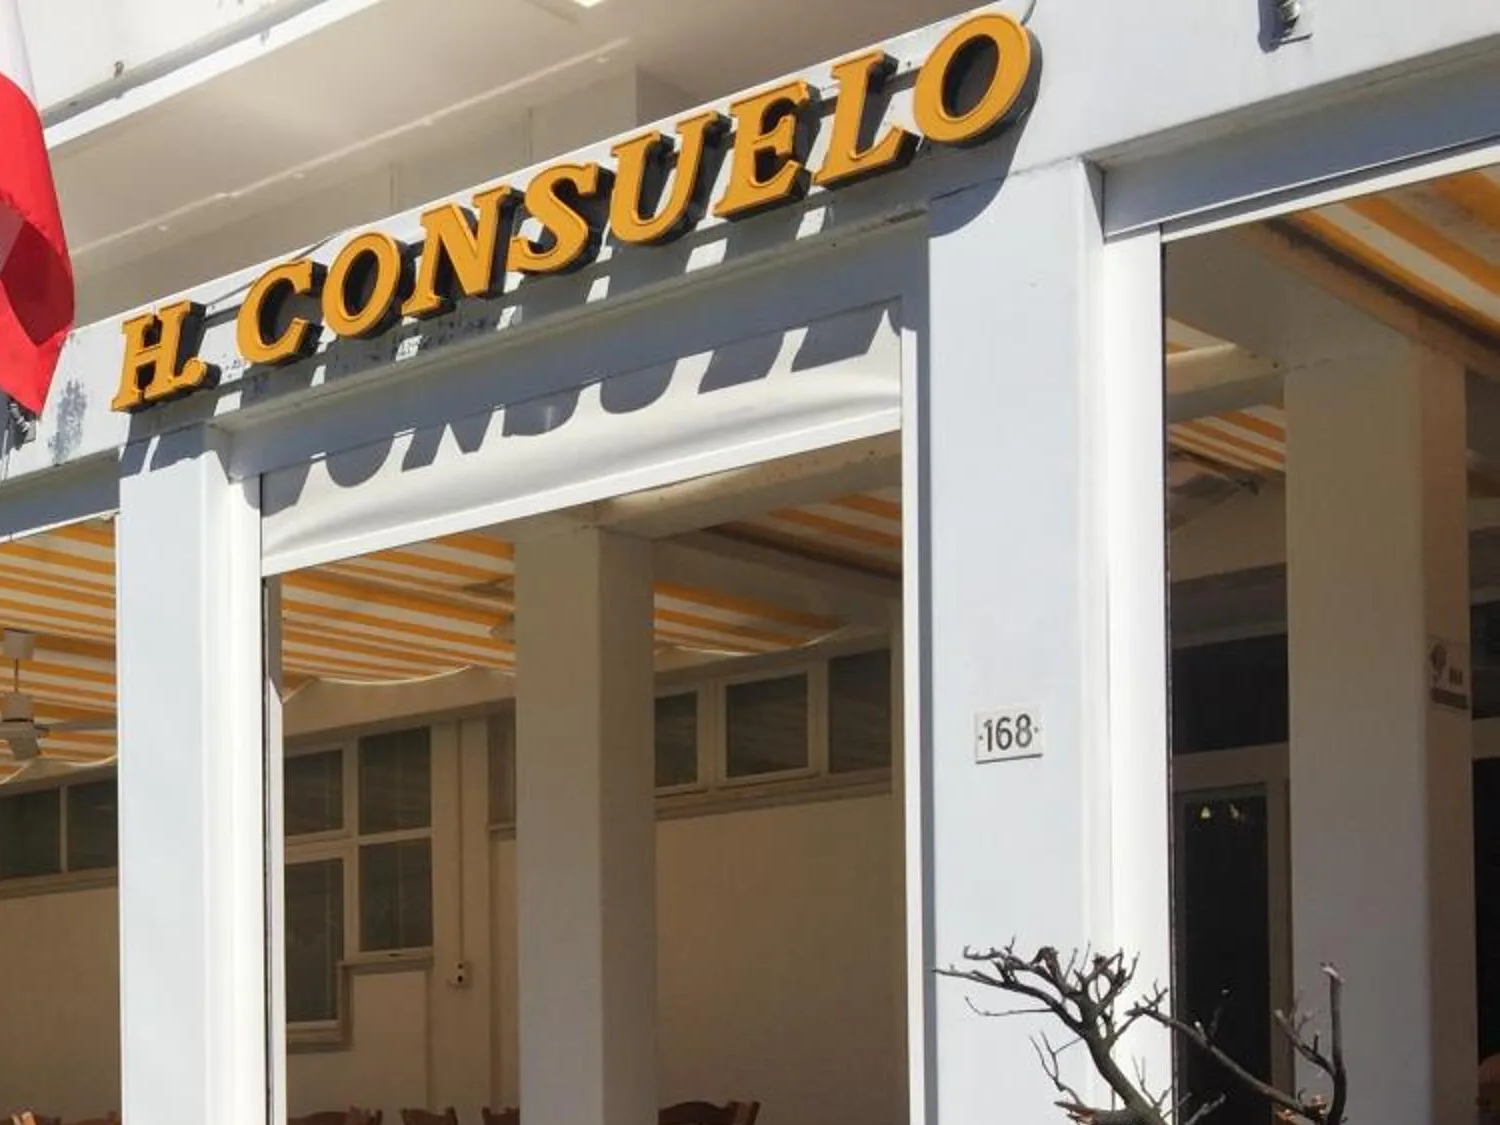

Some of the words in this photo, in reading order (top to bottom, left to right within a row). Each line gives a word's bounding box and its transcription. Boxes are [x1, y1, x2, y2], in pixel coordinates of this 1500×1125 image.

[112, 300, 211, 412] H.
[235, 12, 1035, 367] CONSUELO
[983, 713, 1033, 752] 168
